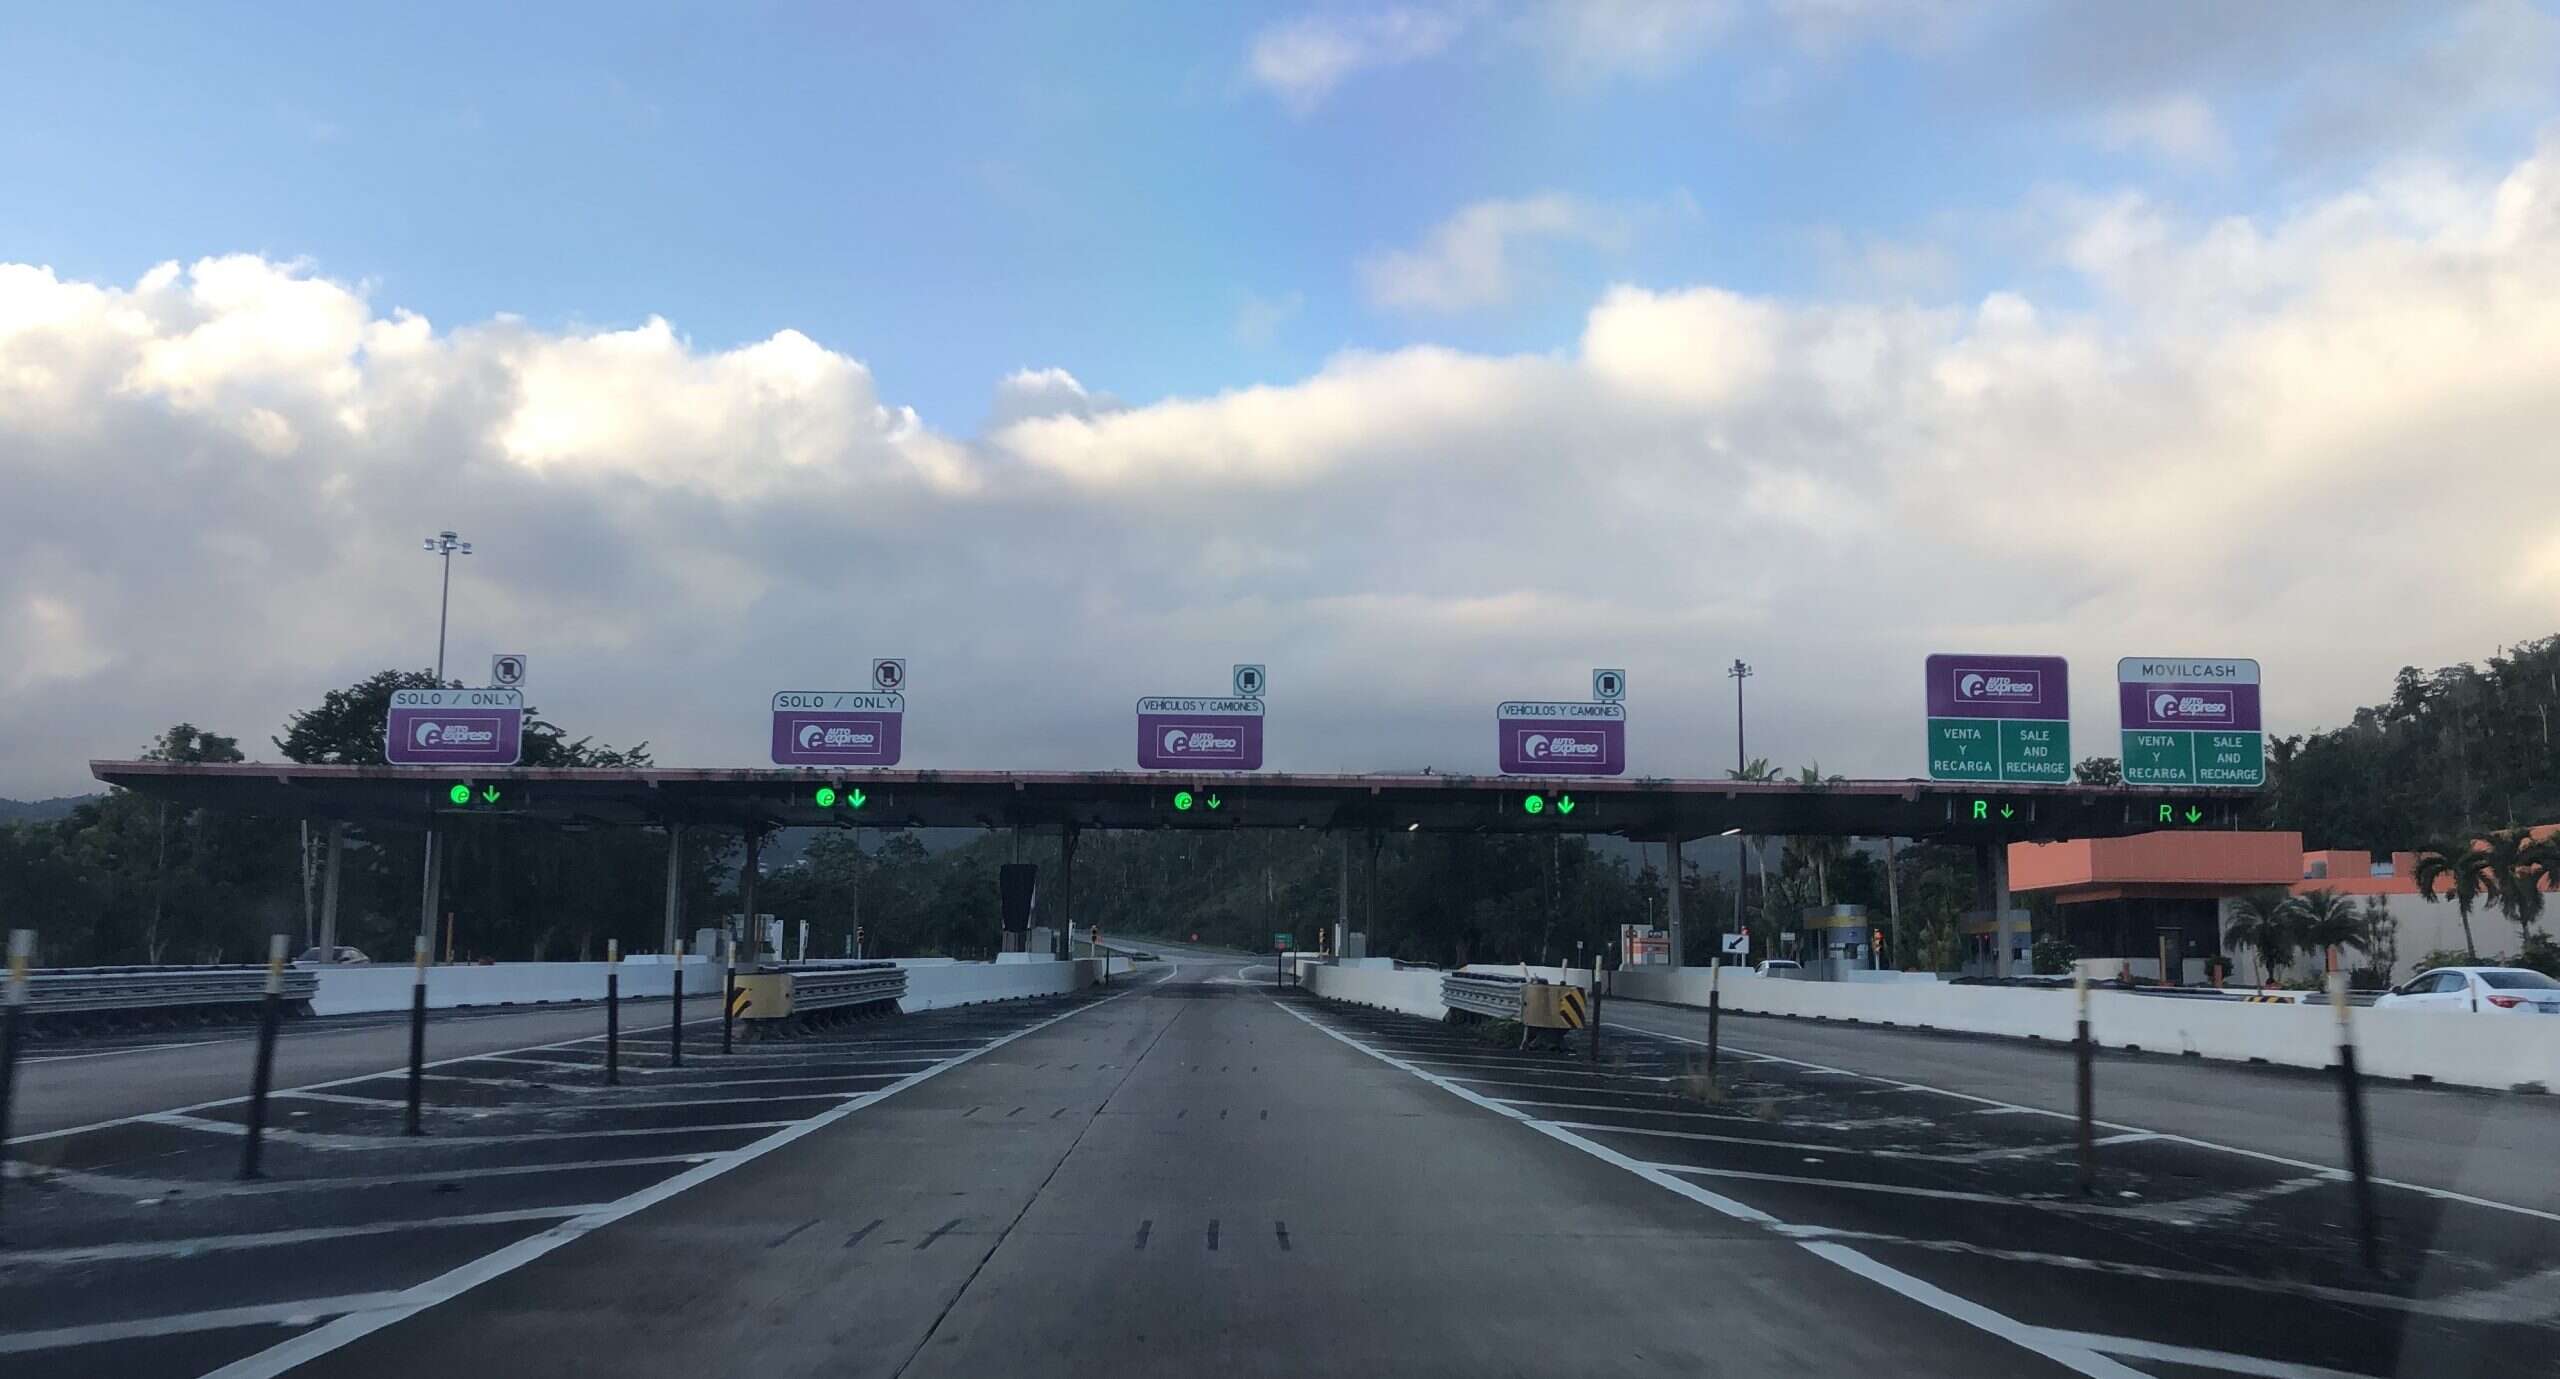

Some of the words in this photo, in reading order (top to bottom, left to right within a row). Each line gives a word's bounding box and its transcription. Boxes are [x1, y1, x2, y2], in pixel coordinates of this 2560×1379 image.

[2142, 664, 2236, 677] MOVILCASH
[396, 693, 442, 705] SOLO
[471, 693, 517, 706] ONLY
[780, 695, 824, 708] SOLO
[853, 696, 898, 709] ONLY
[1199, 701, 1206, 711] Y
[1209, 701, 1259, 712] CAMIONES
[1558, 706, 1566, 716] Y
[1570, 706, 1620, 717] CAMIONES
[1944, 728, 1981, 740] VENTA
[2020, 730, 2050, 741] SALE
[2138, 736, 2175, 747] VENTA
[2213, 737, 2243, 748] SALE
[1959, 744, 1968, 756] Y
[2023, 746, 2048, 757] AND
[2152, 752, 2161, 762] Y
[2217, 753, 2241, 764] AND
[1934, 760, 1992, 772] RECARGA
[2006, 762, 2065, 774] RECHARGE
[2128, 768, 2186, 779] RECARGA
[2200, 769, 2258, 780] RECHARGE
[1973, 801, 1987, 819] R
[2159, 805, 2173, 823] R
